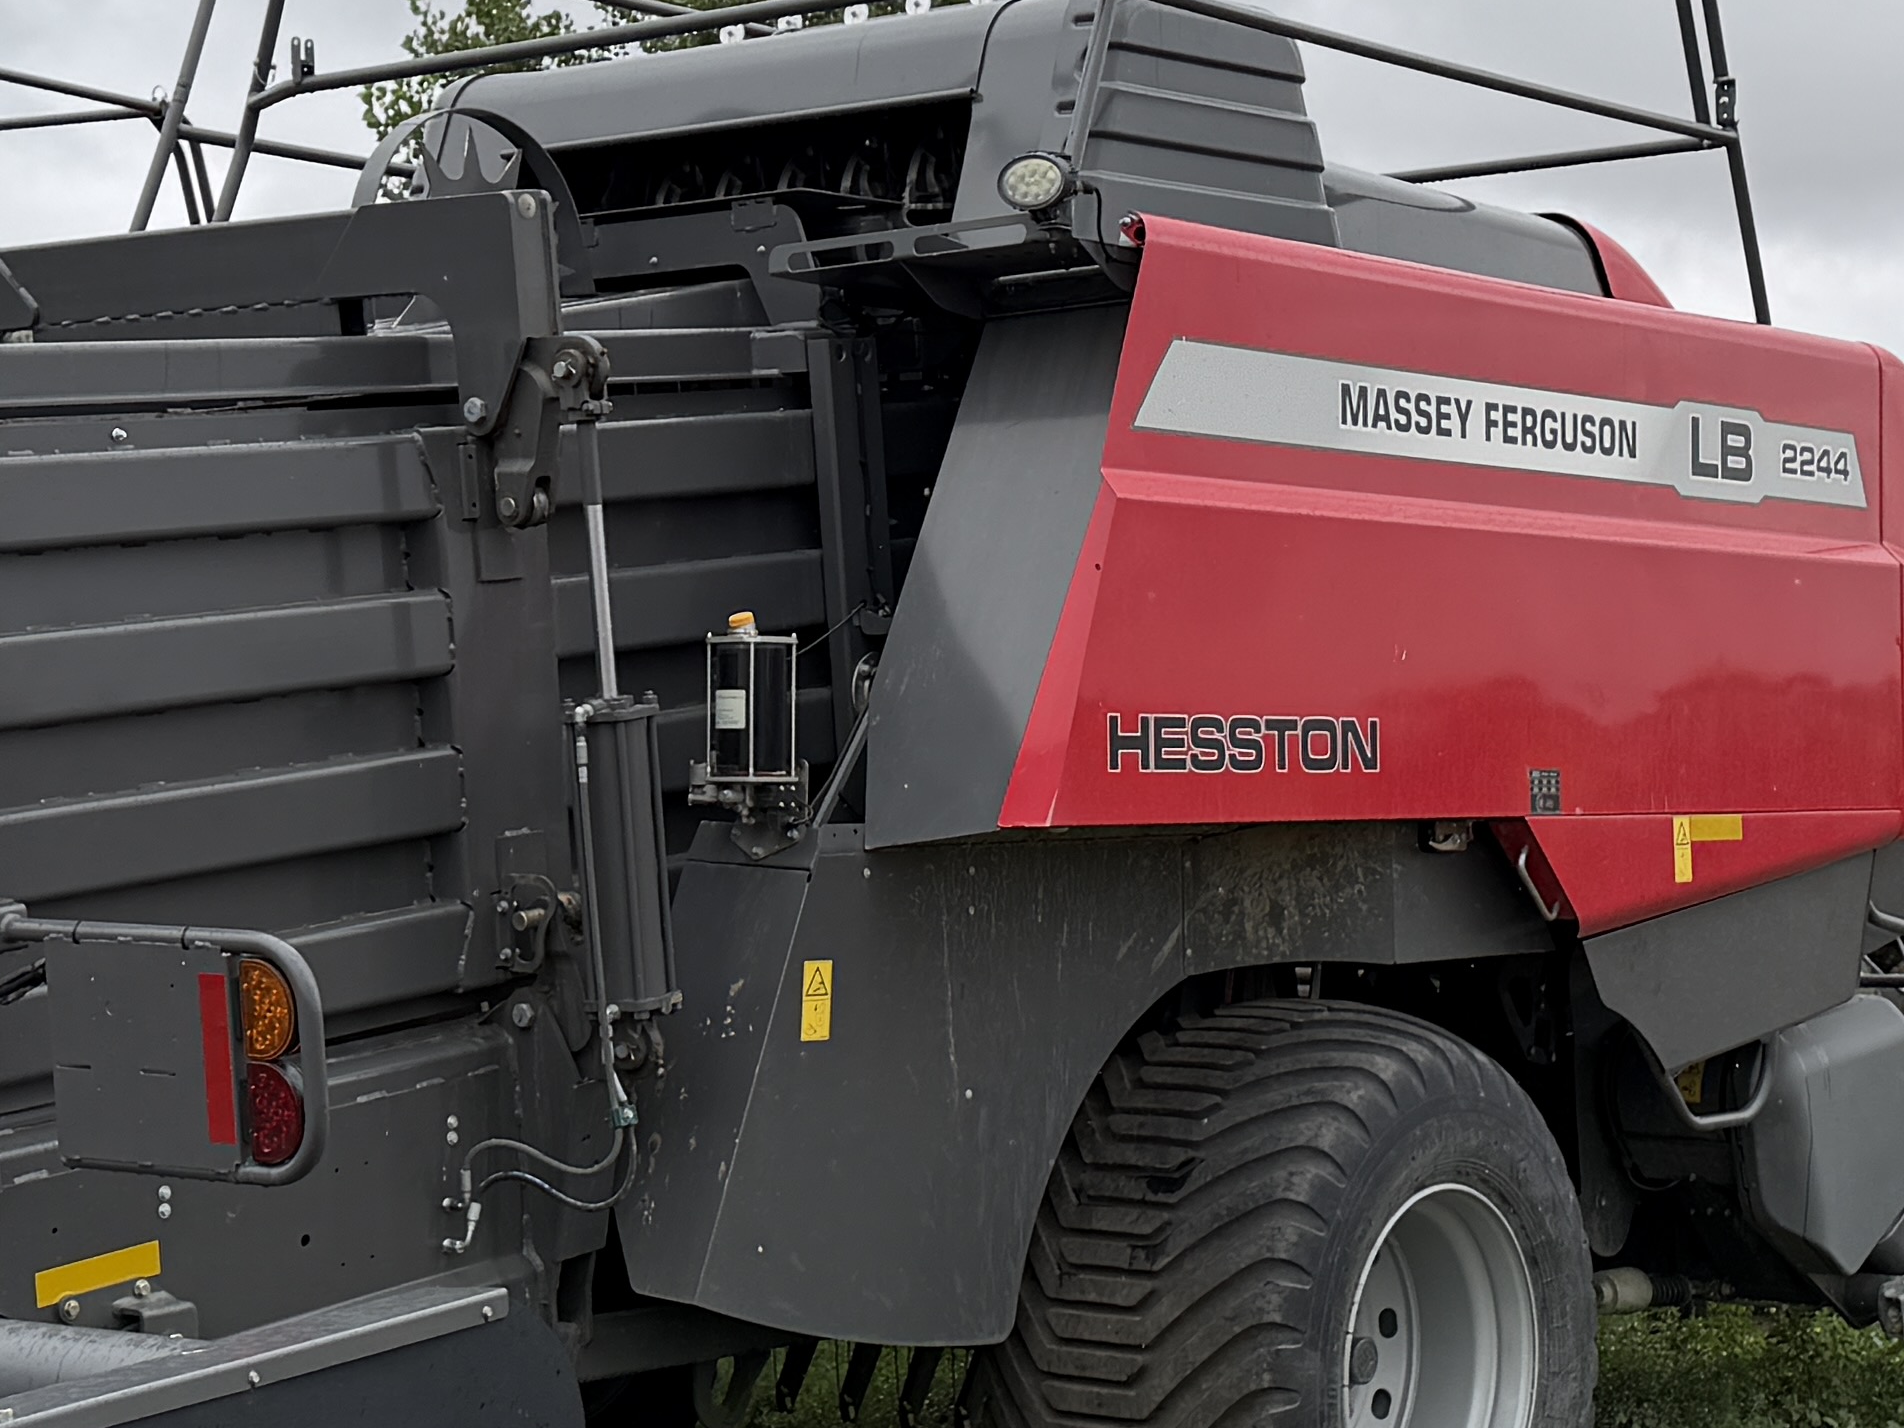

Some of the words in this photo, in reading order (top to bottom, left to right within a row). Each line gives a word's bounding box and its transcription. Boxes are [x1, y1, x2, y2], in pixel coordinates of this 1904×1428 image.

[1340, 382, 1473, 439] MASSEY
[1484, 401, 1638, 459] FERGUSON
[1690, 414, 1754, 483] LB
[1781, 441, 1850, 482] 2244
[1107, 713, 1380, 773] HESSTON
